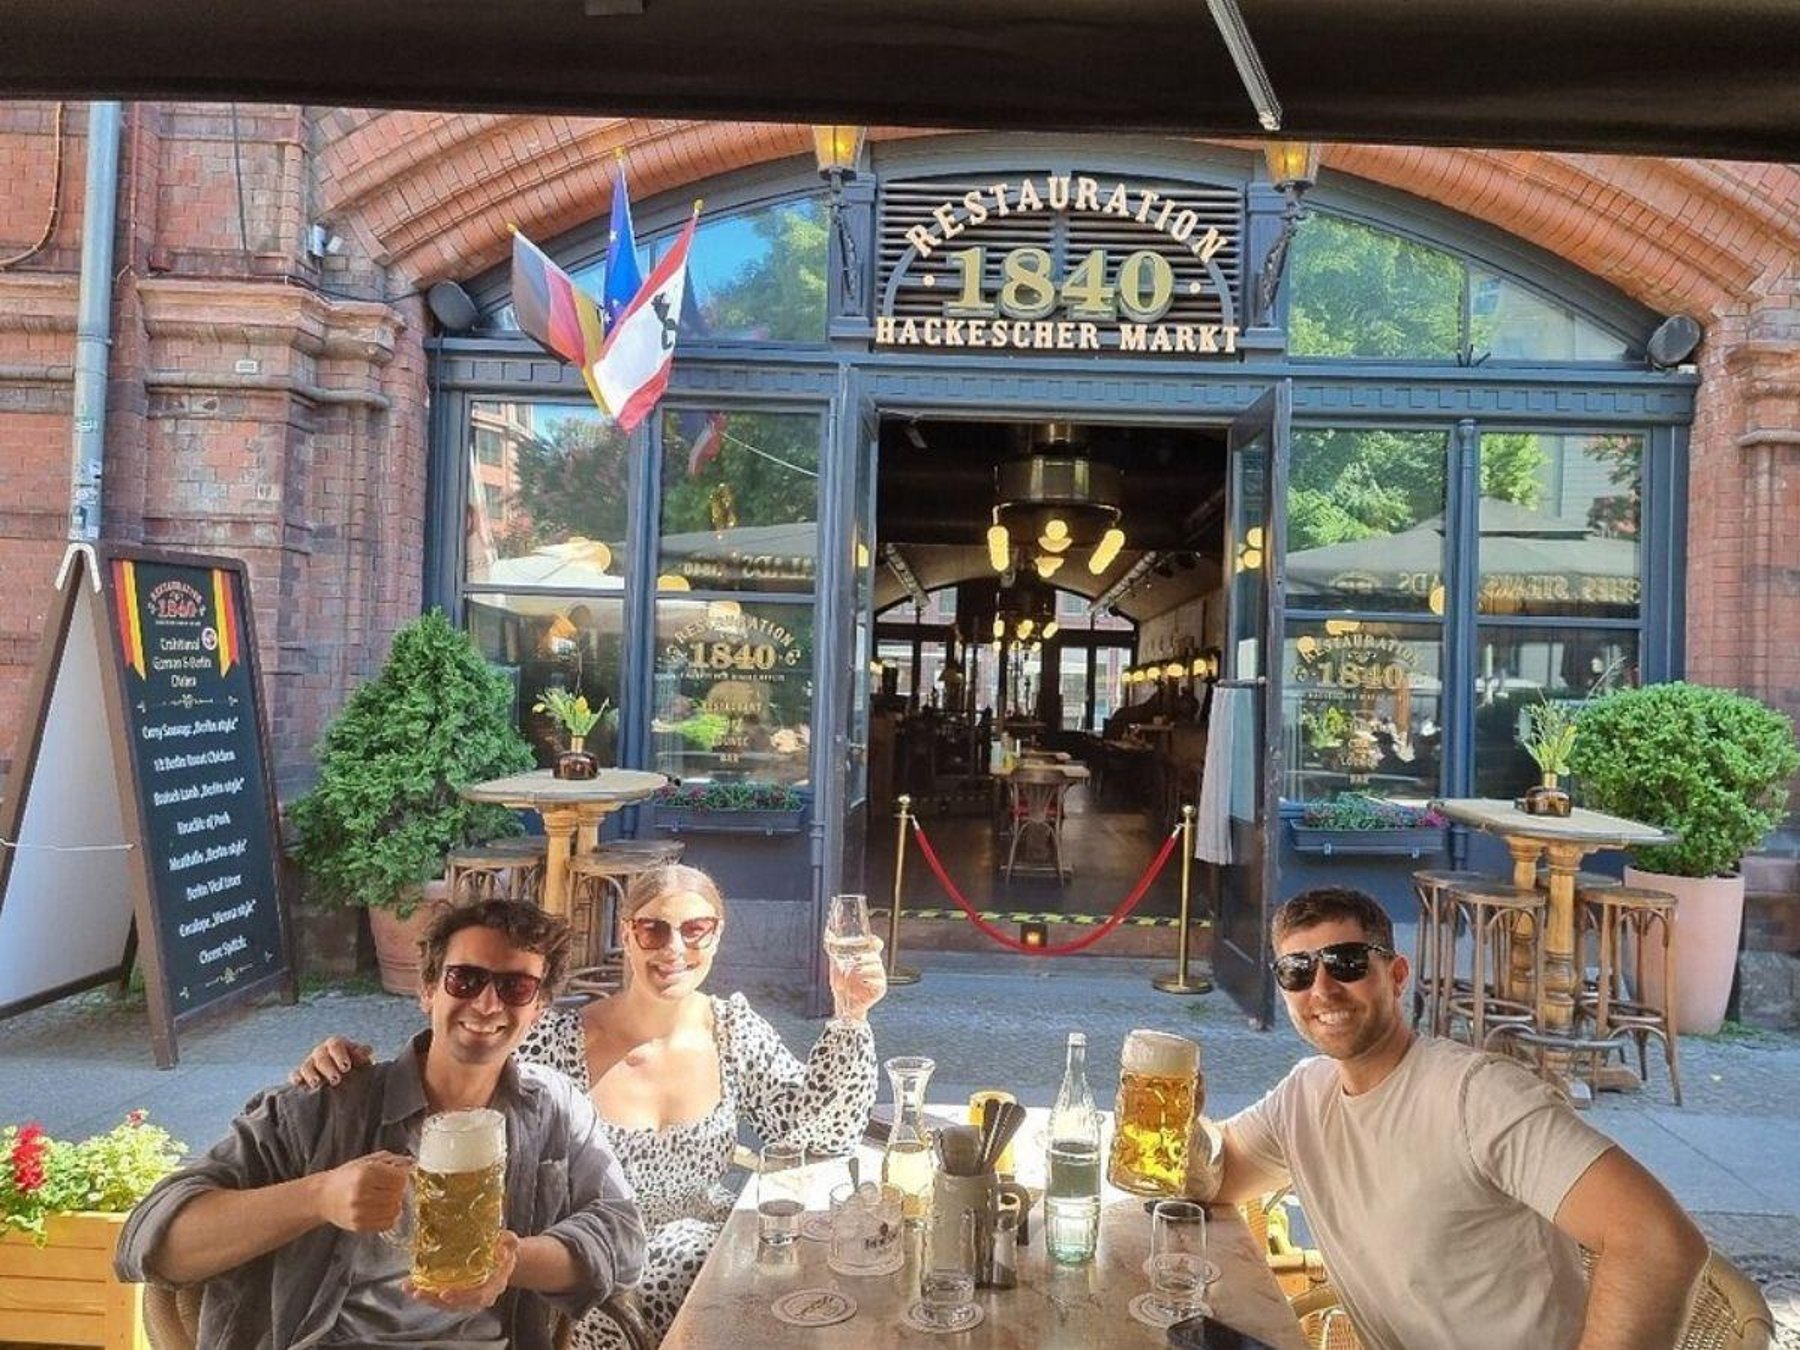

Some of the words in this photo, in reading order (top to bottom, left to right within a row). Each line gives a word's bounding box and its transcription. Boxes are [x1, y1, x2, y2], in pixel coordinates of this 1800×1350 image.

[905, 175, 1228, 264] RESTAURATION
[943, 246, 1175, 322] 1840
[875, 316, 1100, 350] HACKESCHER
[1119, 323, 1240, 353] MARKT
[688, 642, 777, 670] 1840
[1317, 662, 1404, 688] 1840
